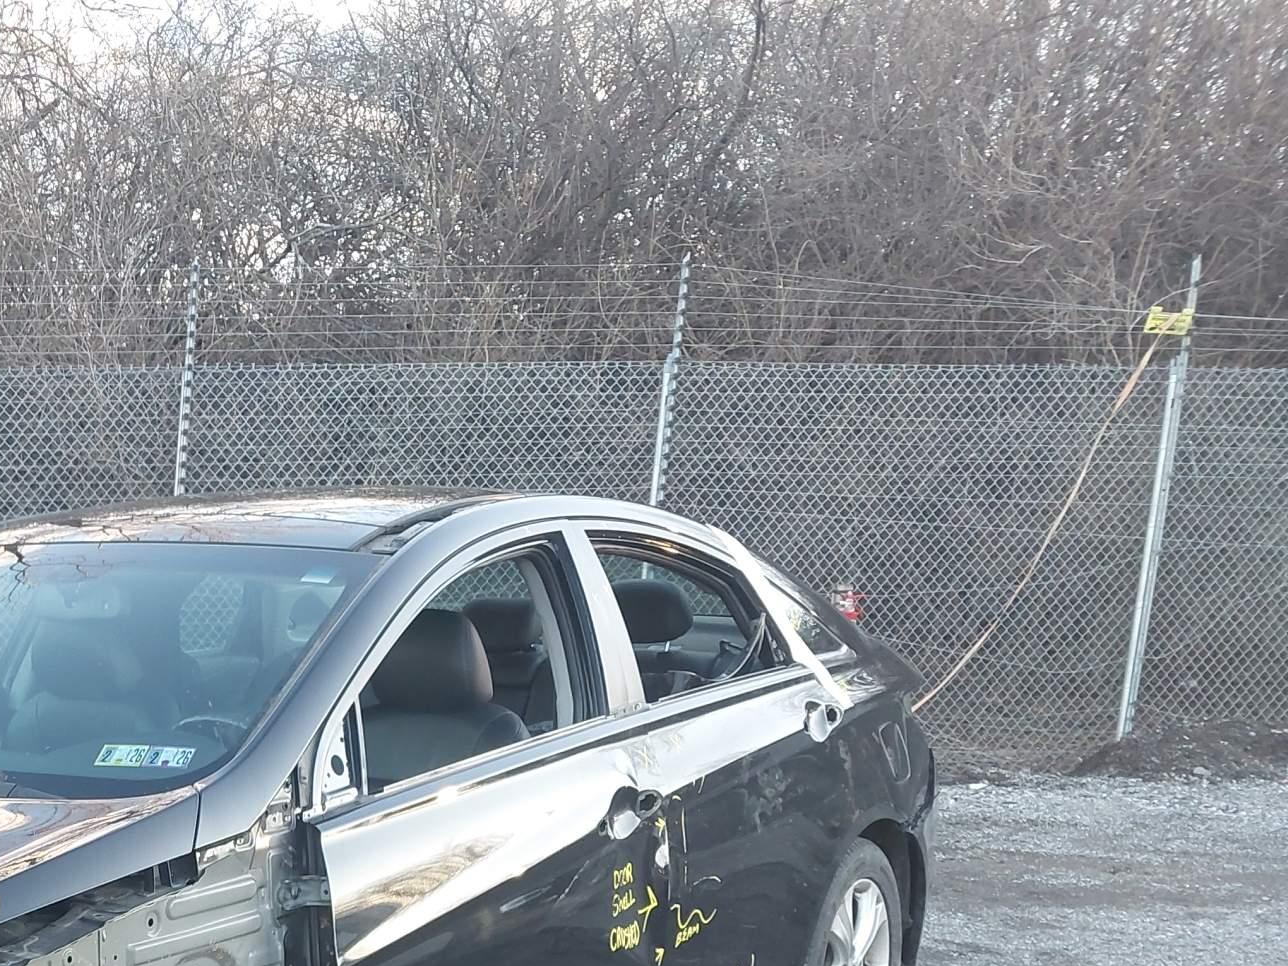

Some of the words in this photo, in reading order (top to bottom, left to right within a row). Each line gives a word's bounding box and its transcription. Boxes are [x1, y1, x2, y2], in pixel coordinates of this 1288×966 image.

[101, 750, 113, 763] 2
[129, 748, 146, 763] 26
[150, 751, 160, 764] 2
[675, 923, 700, 948] BEAM
